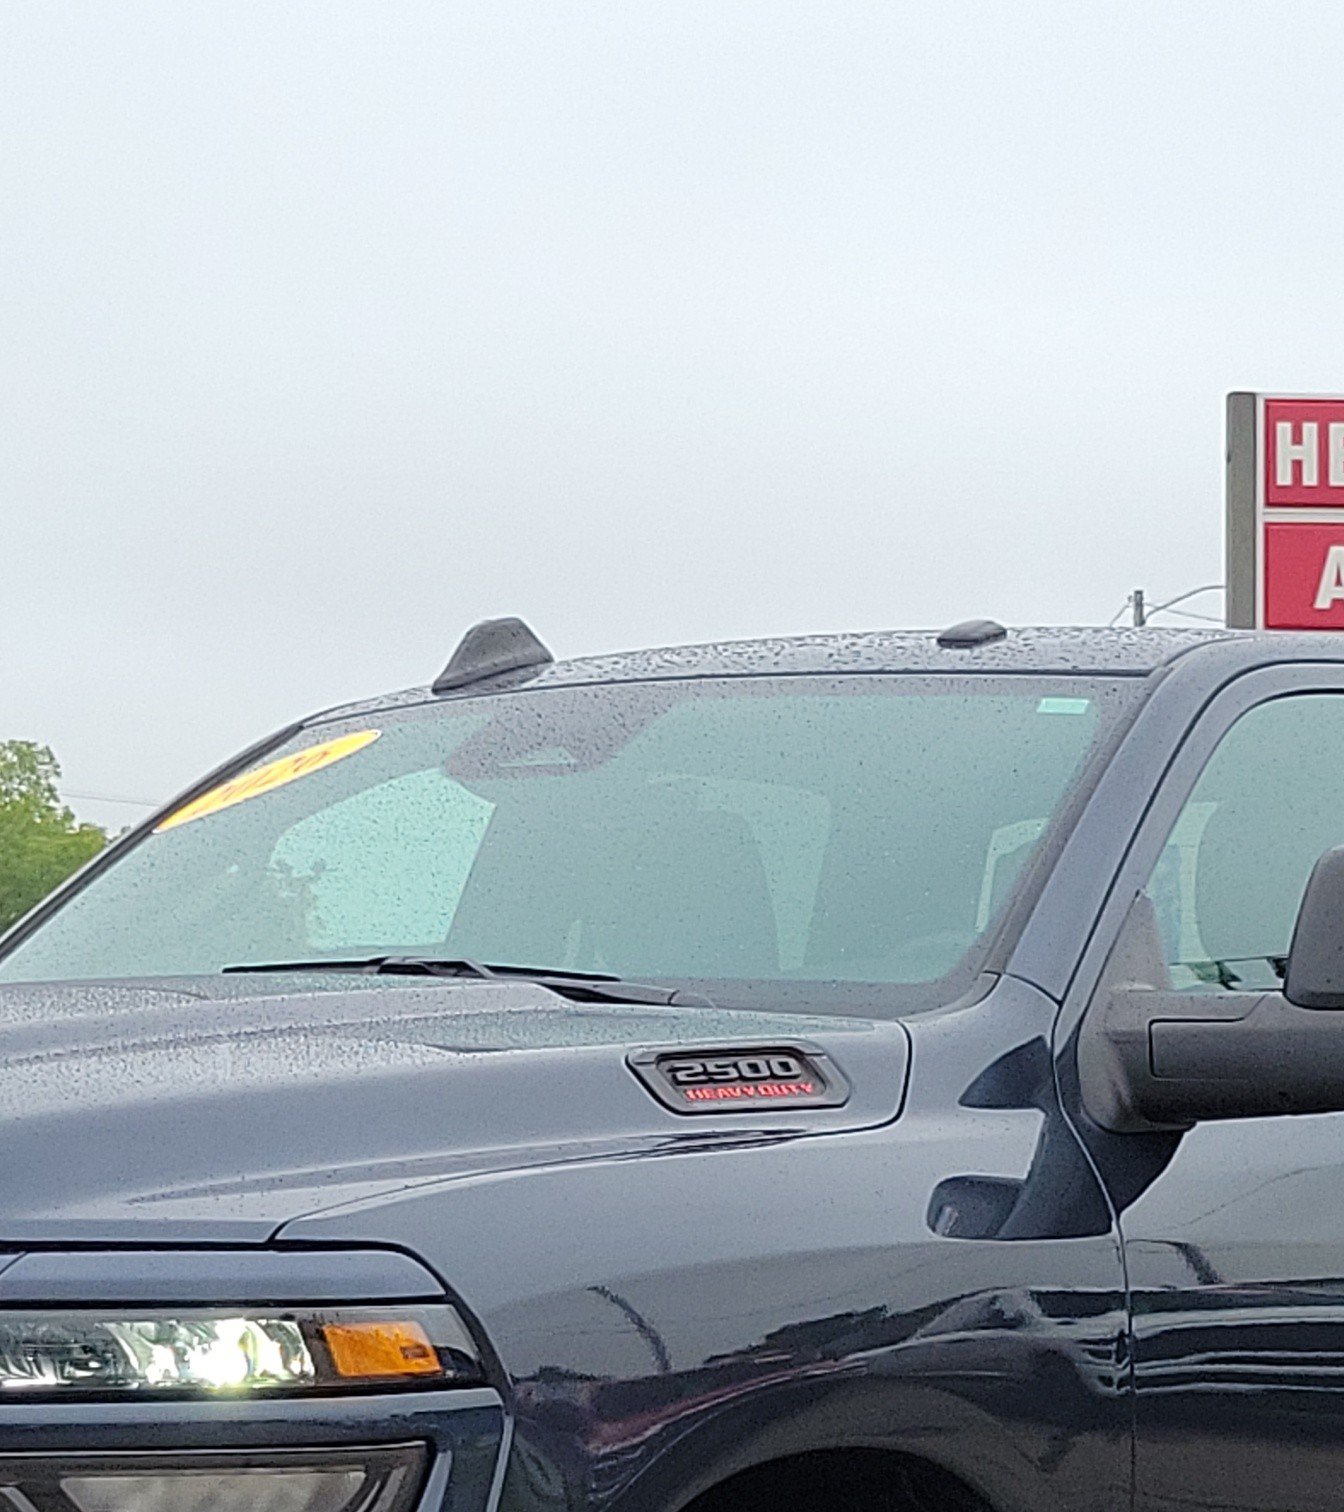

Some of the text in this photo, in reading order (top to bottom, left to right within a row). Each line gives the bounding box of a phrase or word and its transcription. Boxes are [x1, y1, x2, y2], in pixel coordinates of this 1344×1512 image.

[672, 1057, 802, 1083] 2500
[685, 1082, 813, 1101] HEAVY DUTY
